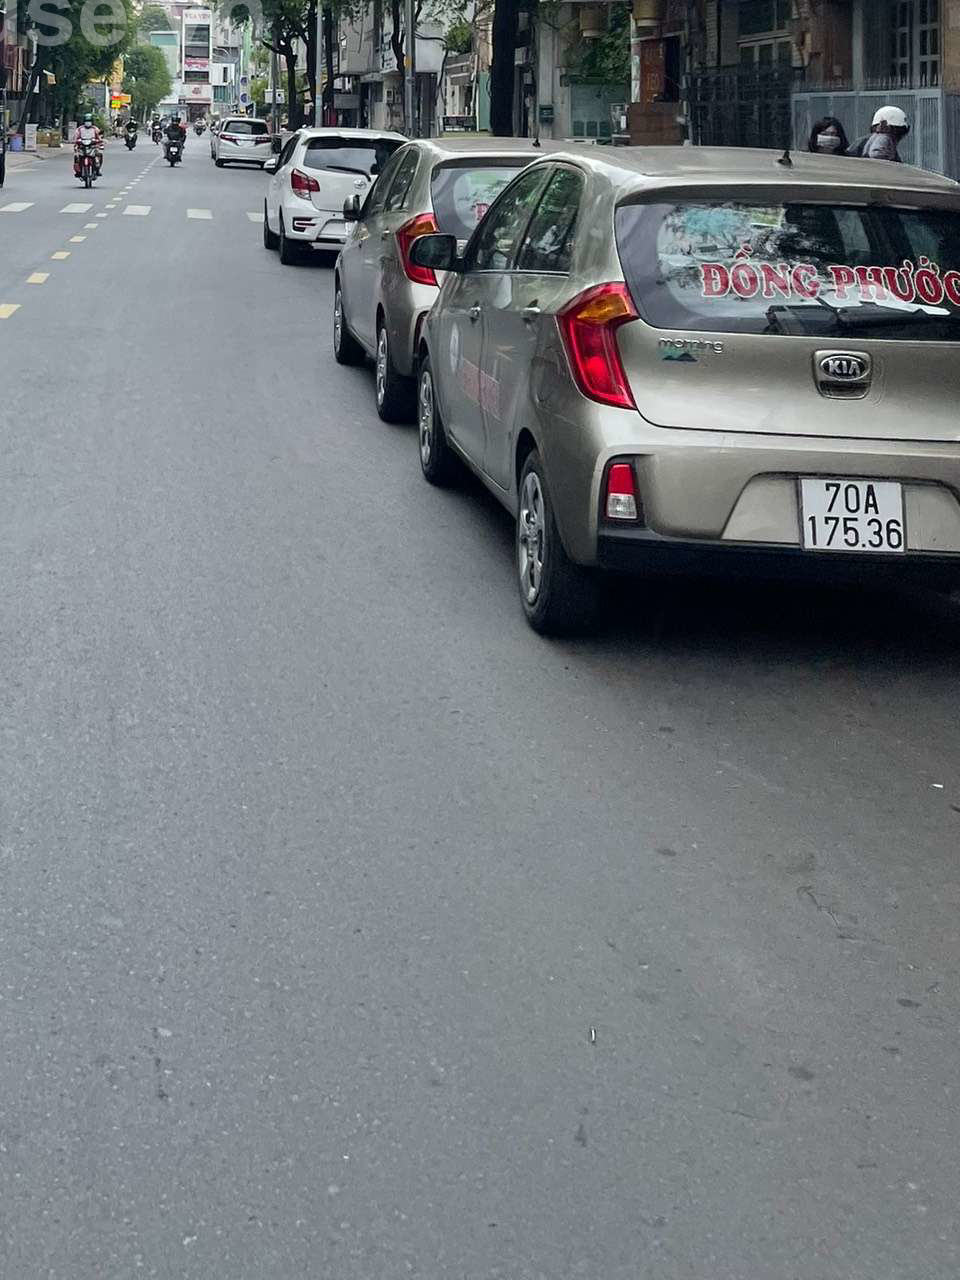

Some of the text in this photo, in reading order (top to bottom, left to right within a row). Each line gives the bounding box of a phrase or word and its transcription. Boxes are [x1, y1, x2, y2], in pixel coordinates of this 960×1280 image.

[658, 337, 724, 355] morning
[827, 358, 862, 377] KIA
[825, 482, 880, 515] 70A
[807, 515, 903, 549] 175.36
